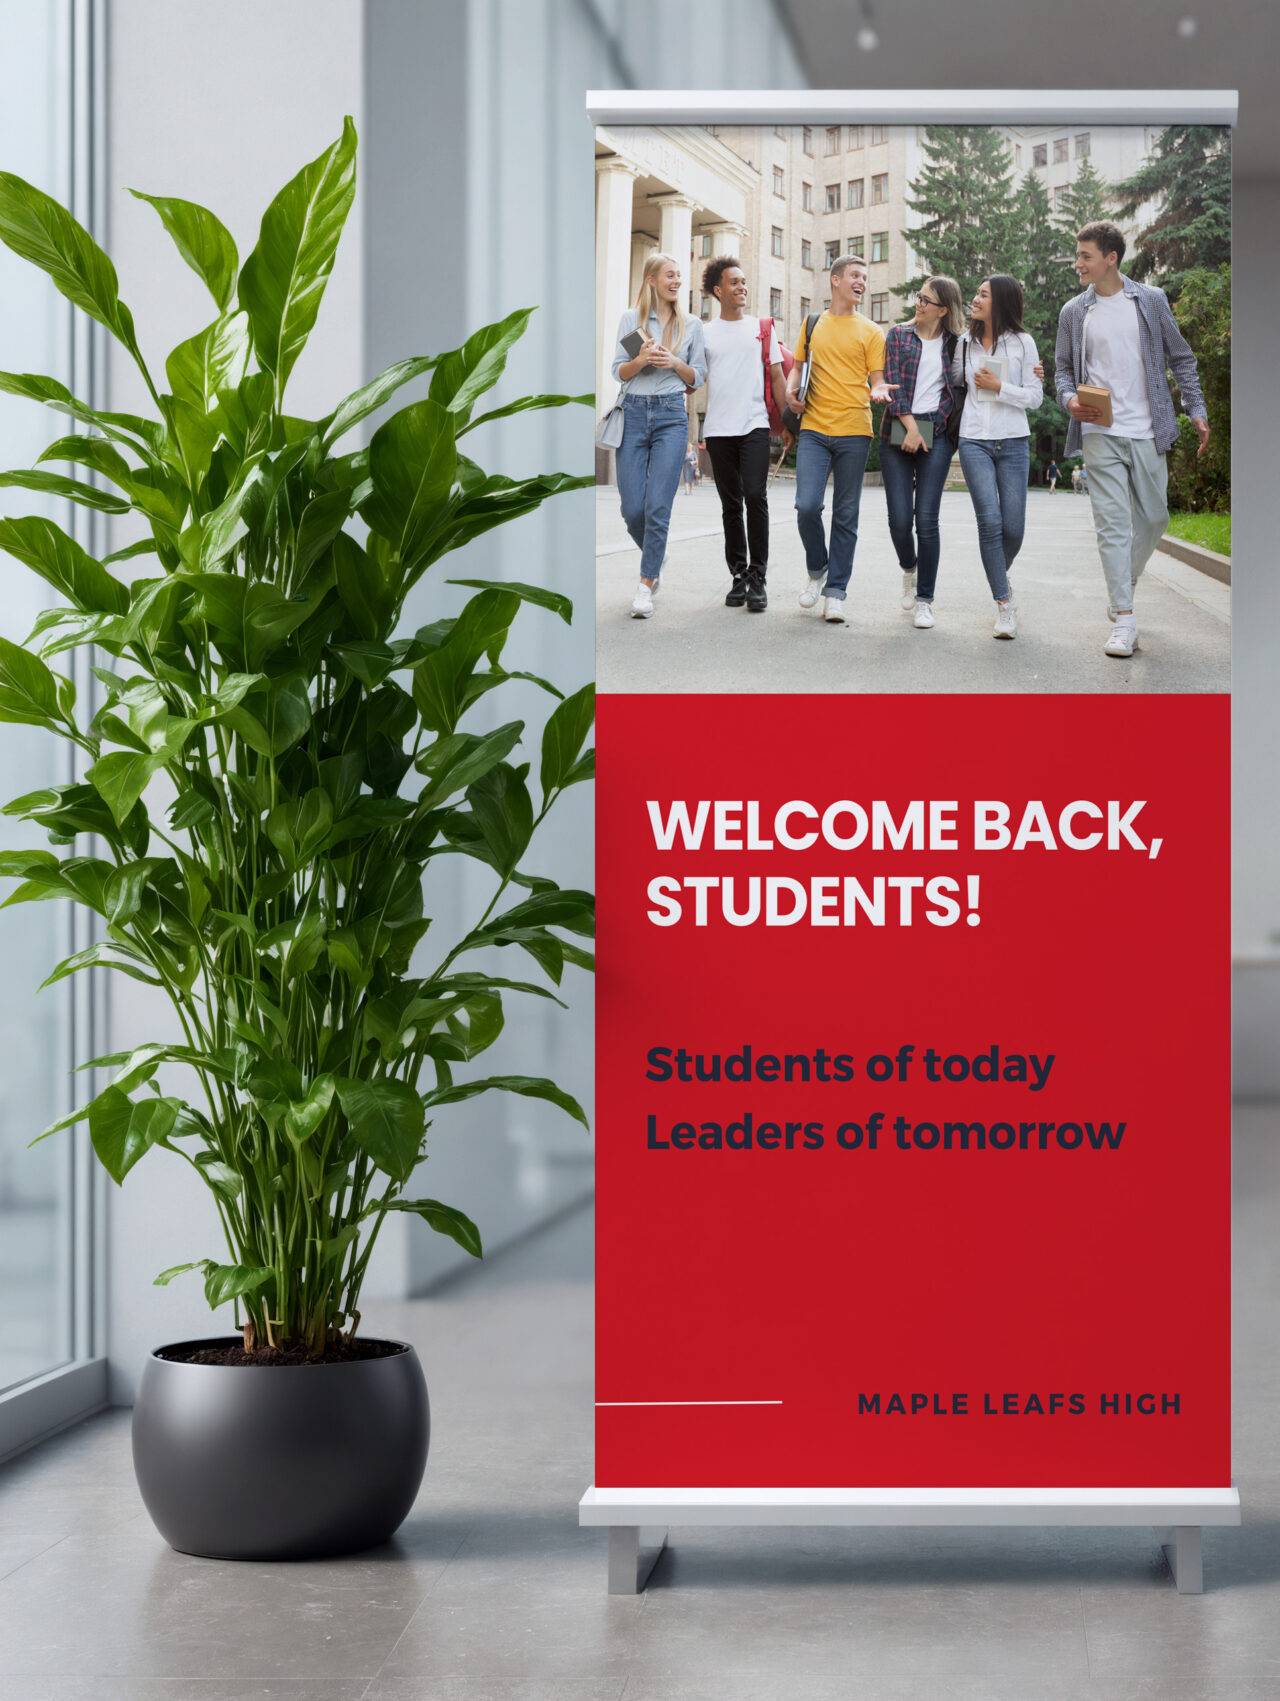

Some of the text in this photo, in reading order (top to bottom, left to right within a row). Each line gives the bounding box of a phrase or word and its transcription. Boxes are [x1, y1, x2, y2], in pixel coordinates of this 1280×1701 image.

[646, 800, 1164, 860] WELCOME BACK,
[646, 875, 981, 927] STUDENTS!
[645, 1045, 1056, 1091] Students of today
[646, 1112, 1127, 1151] Leaders of tomorrow
[857, 1392, 1181, 1416] MAPLE LEAFS HIGH
